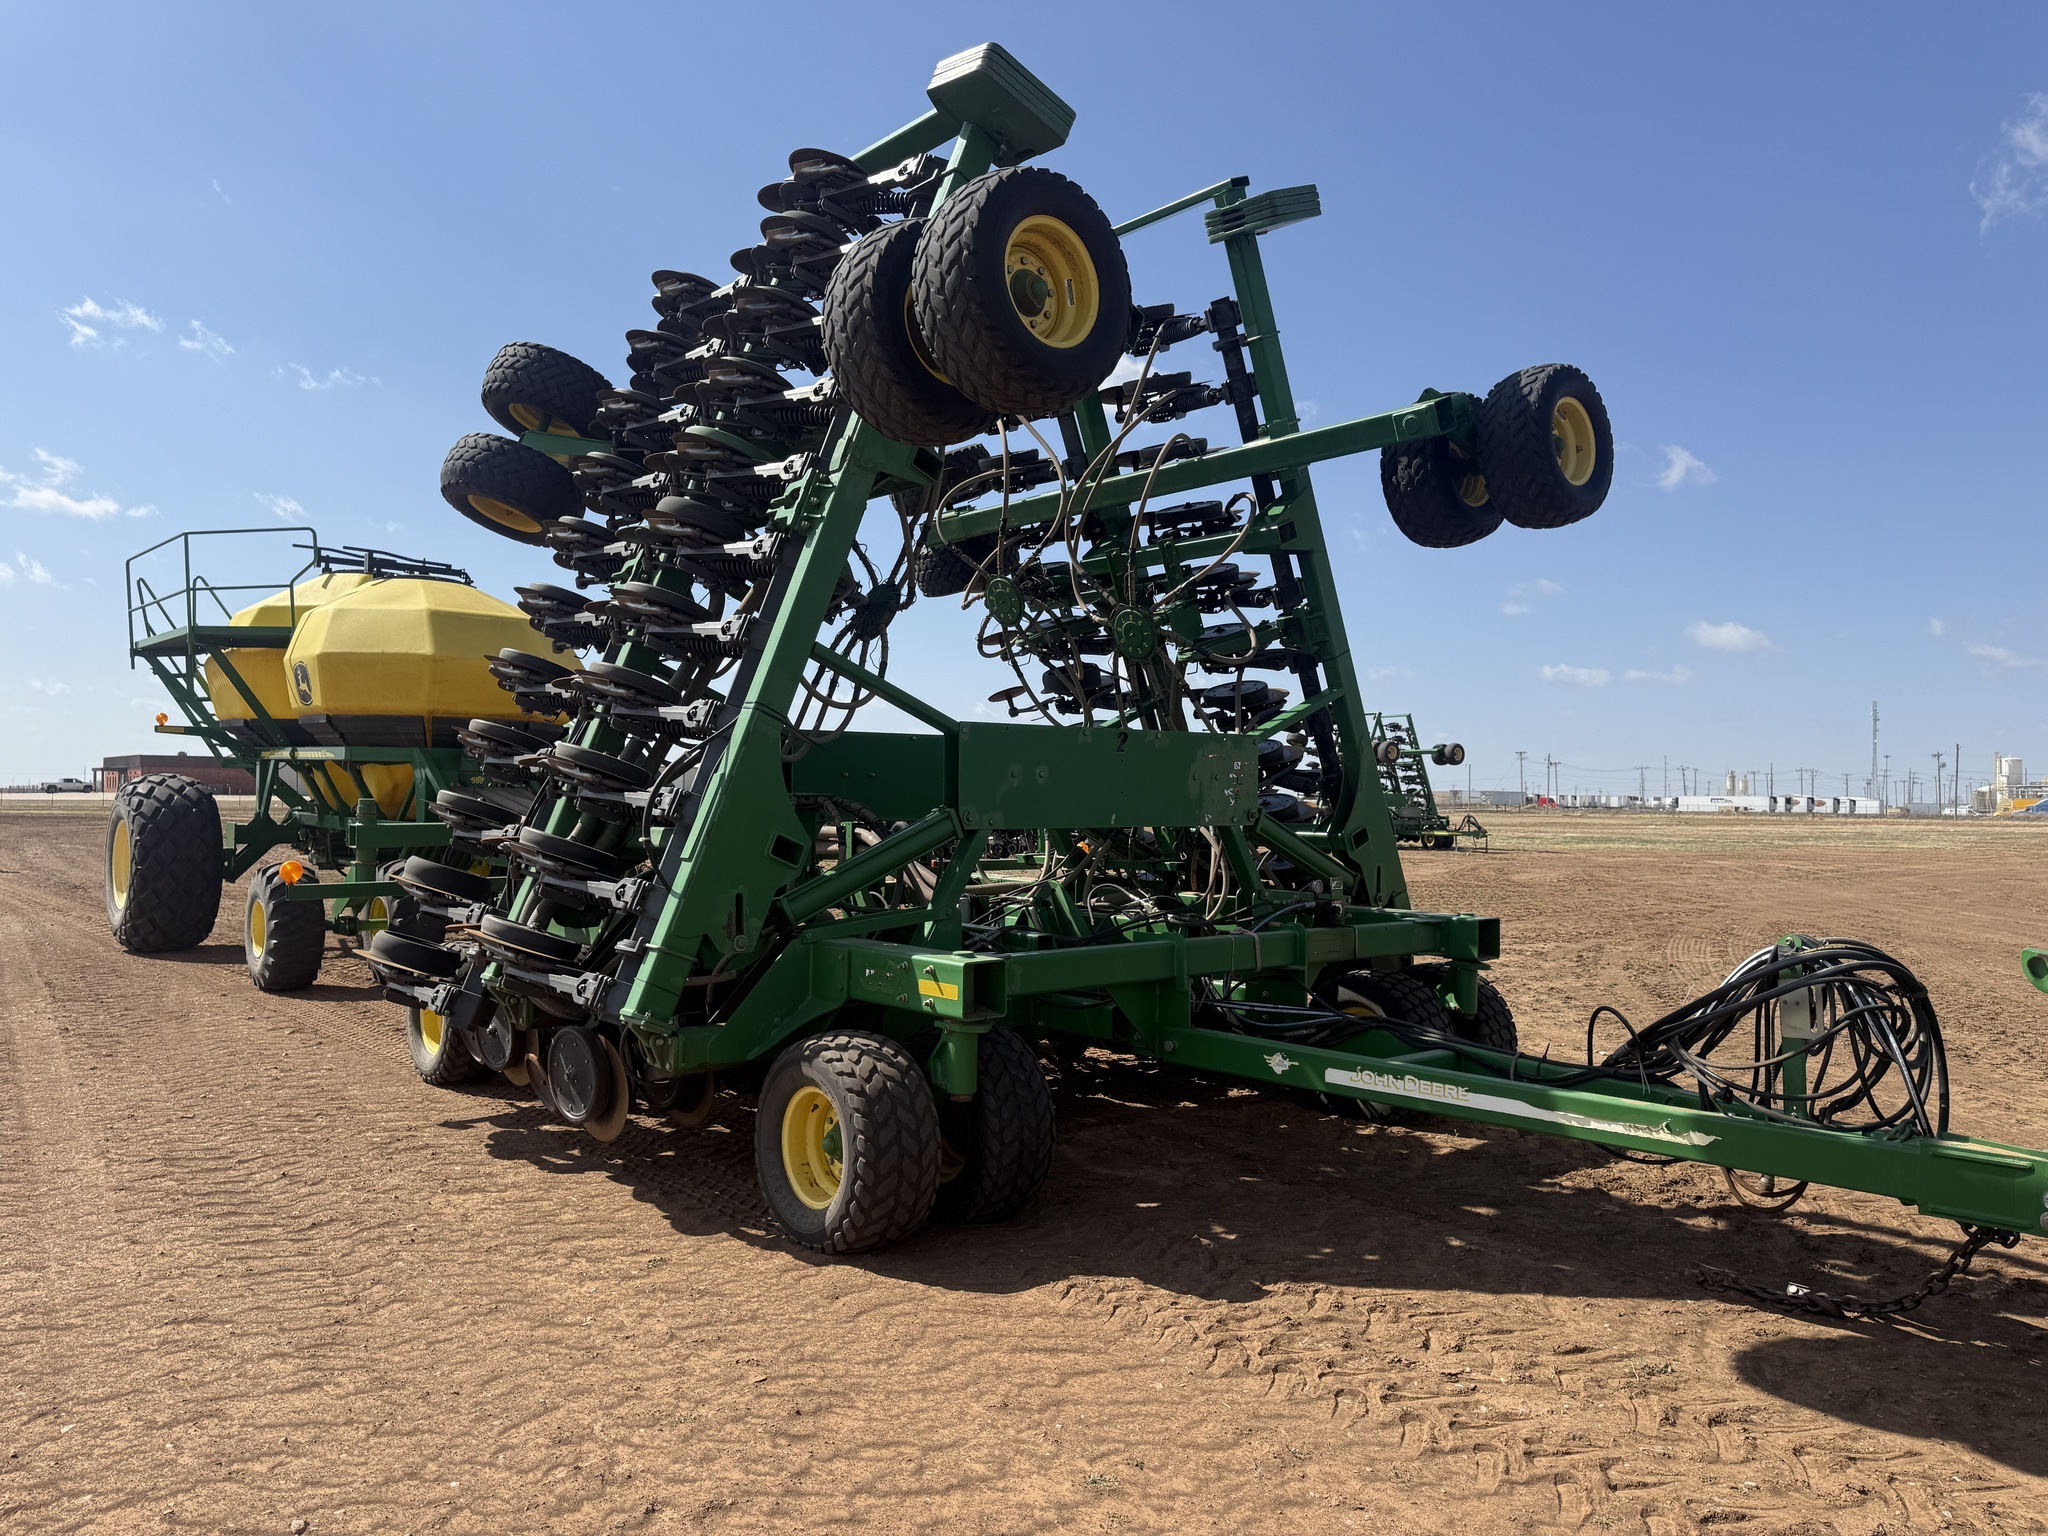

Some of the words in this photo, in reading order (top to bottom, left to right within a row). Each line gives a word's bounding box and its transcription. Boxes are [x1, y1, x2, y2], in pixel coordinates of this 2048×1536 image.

[1116, 731, 1128, 752] 2
[1350, 1066, 1400, 1090] JOHN
[1403, 1075, 1469, 1101] DEERE
